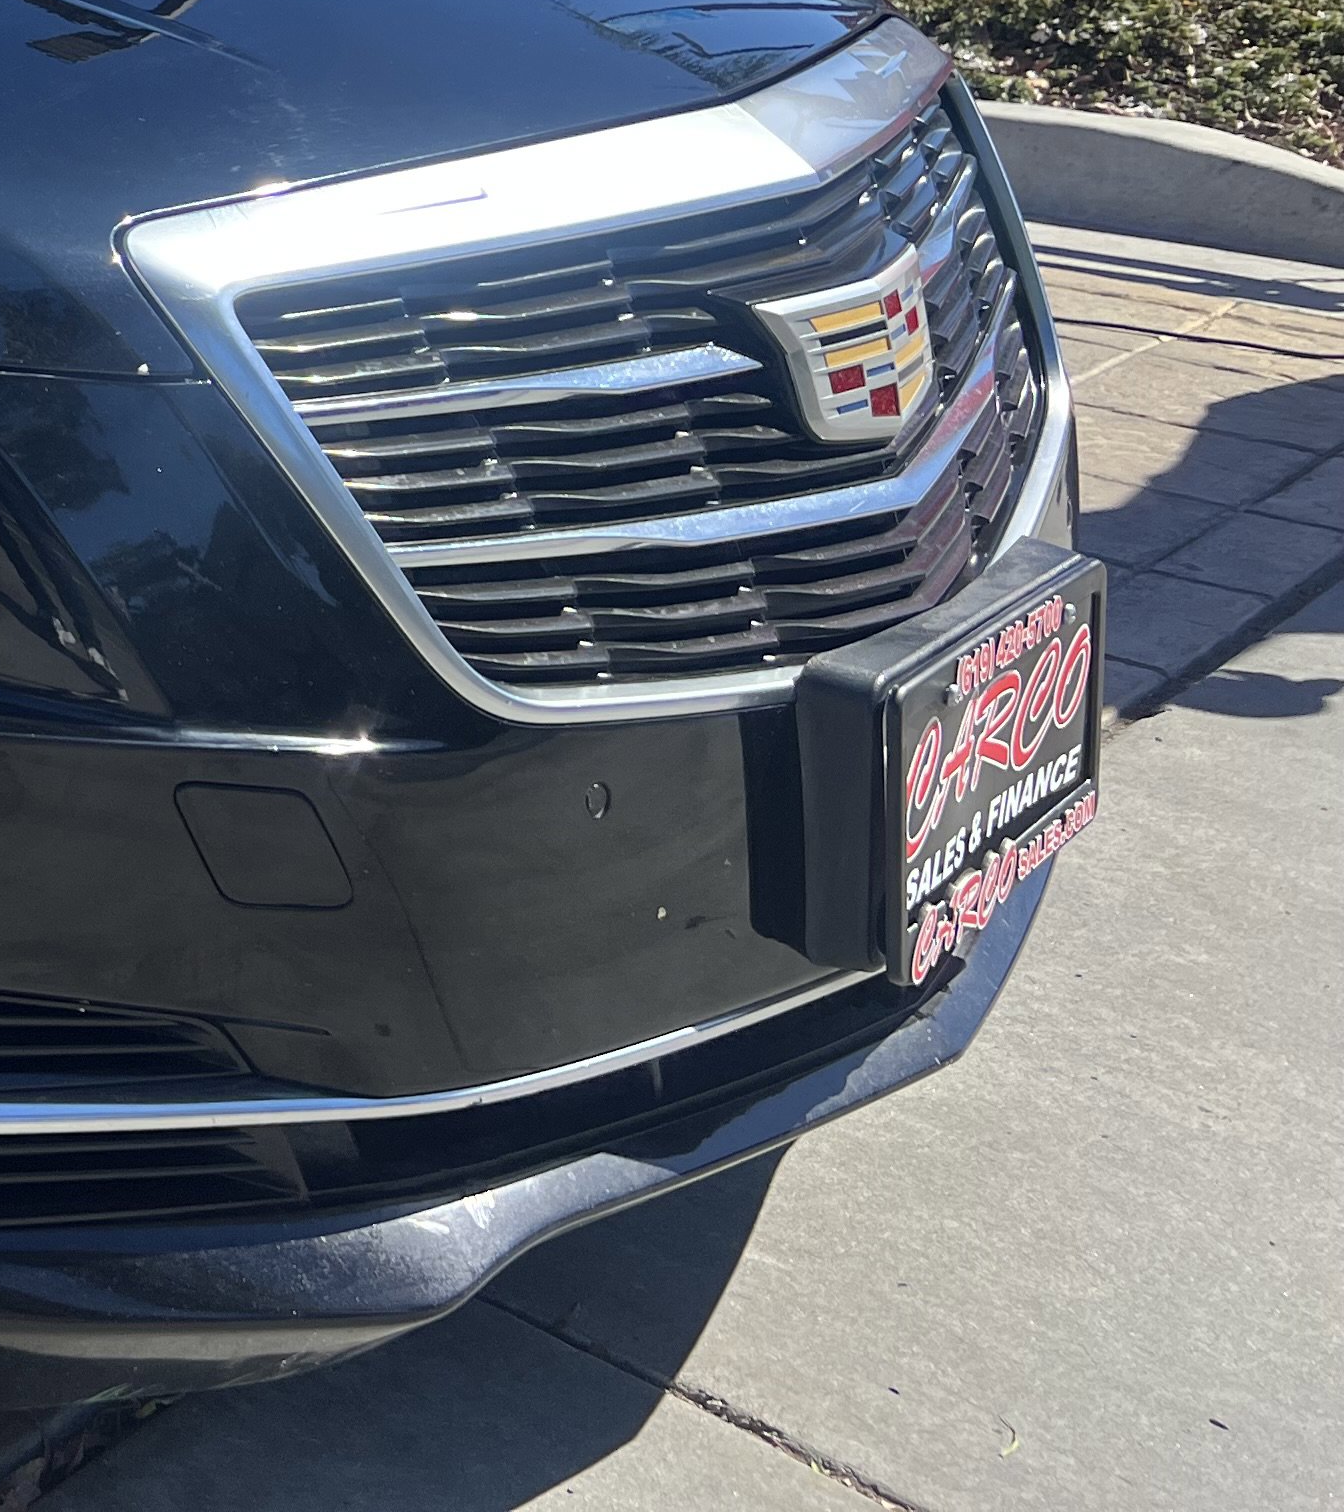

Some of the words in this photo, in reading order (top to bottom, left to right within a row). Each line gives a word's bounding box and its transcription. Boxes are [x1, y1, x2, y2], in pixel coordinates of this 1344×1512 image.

[956, 637, 997, 696] (619)
[995, 594, 1064, 669] 420-5700
[904, 623, 1092, 863] CARCO
[906, 826, 967, 911] SALES
[968, 810, 983, 854] &
[985, 743, 1083, 839] FINANCE
